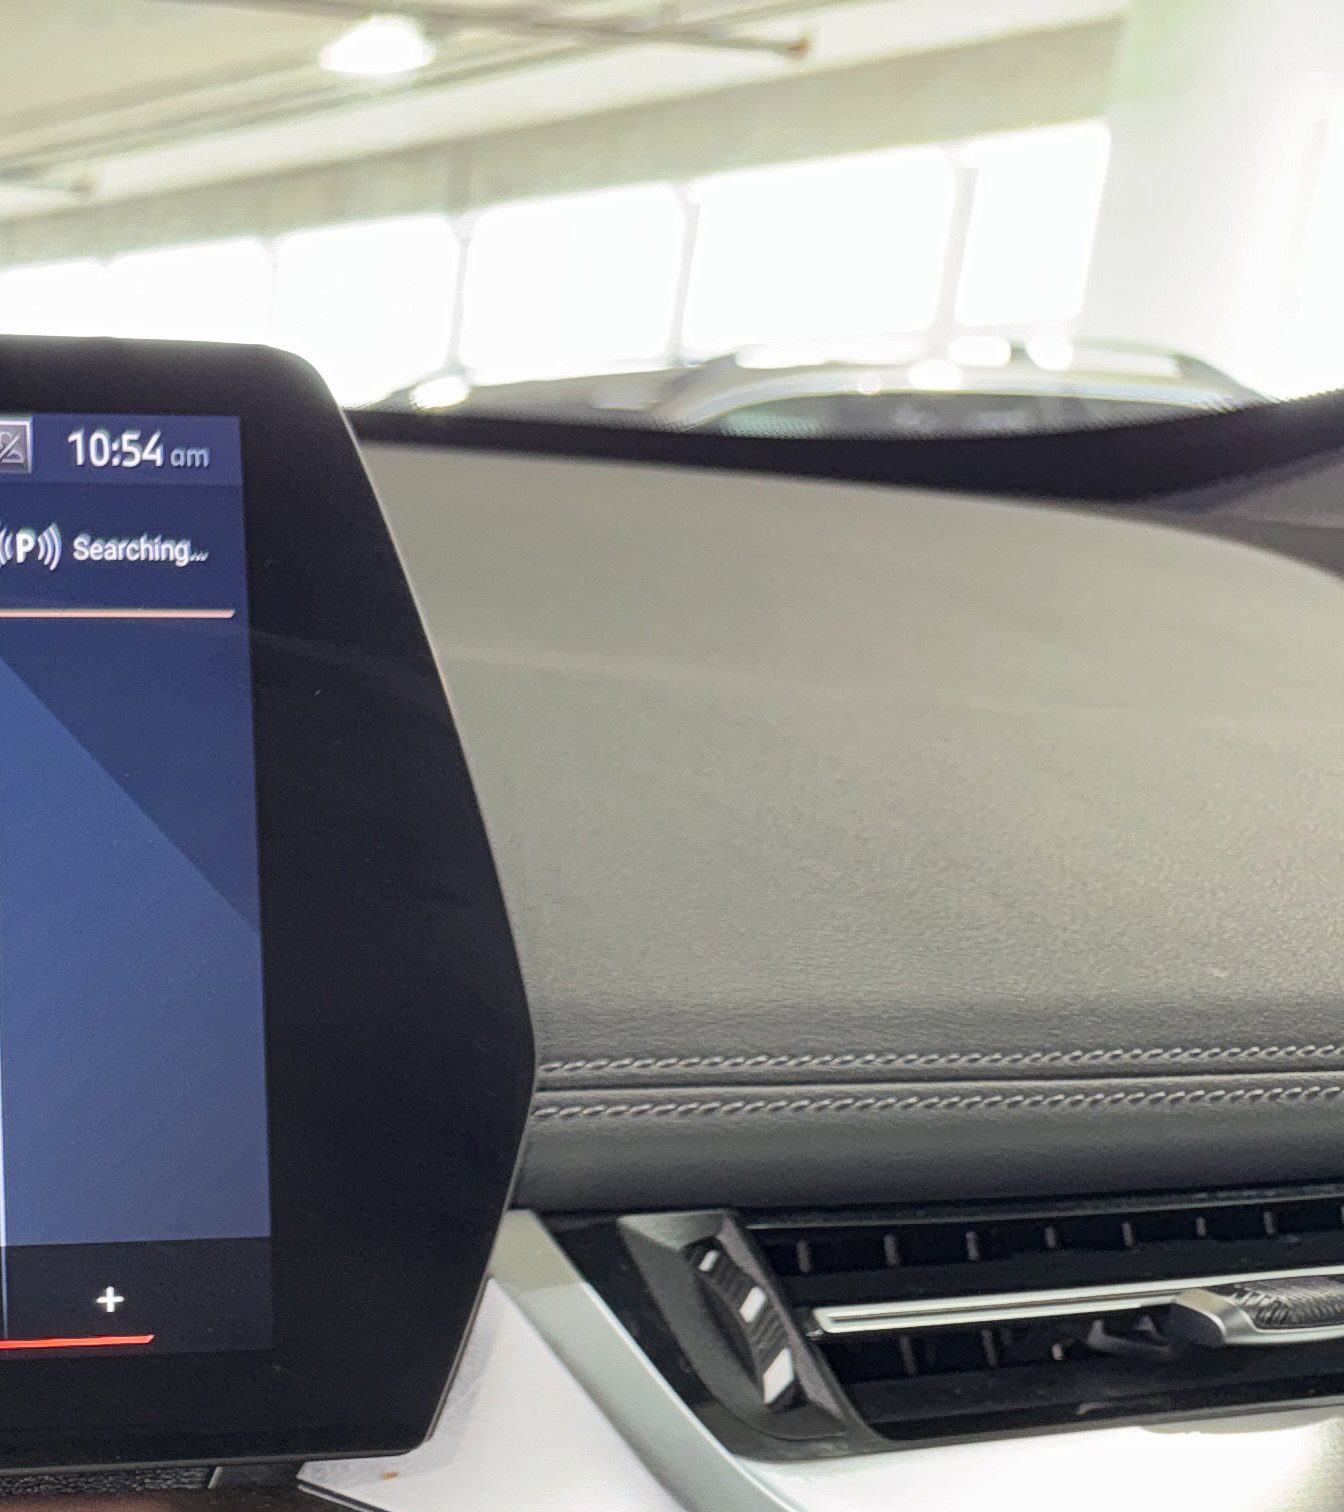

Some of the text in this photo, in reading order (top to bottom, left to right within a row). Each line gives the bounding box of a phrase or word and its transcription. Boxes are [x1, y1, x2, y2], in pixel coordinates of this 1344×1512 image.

[67, 430, 210, 469] 10:54 am
[72, 532, 209, 567] Searching...
